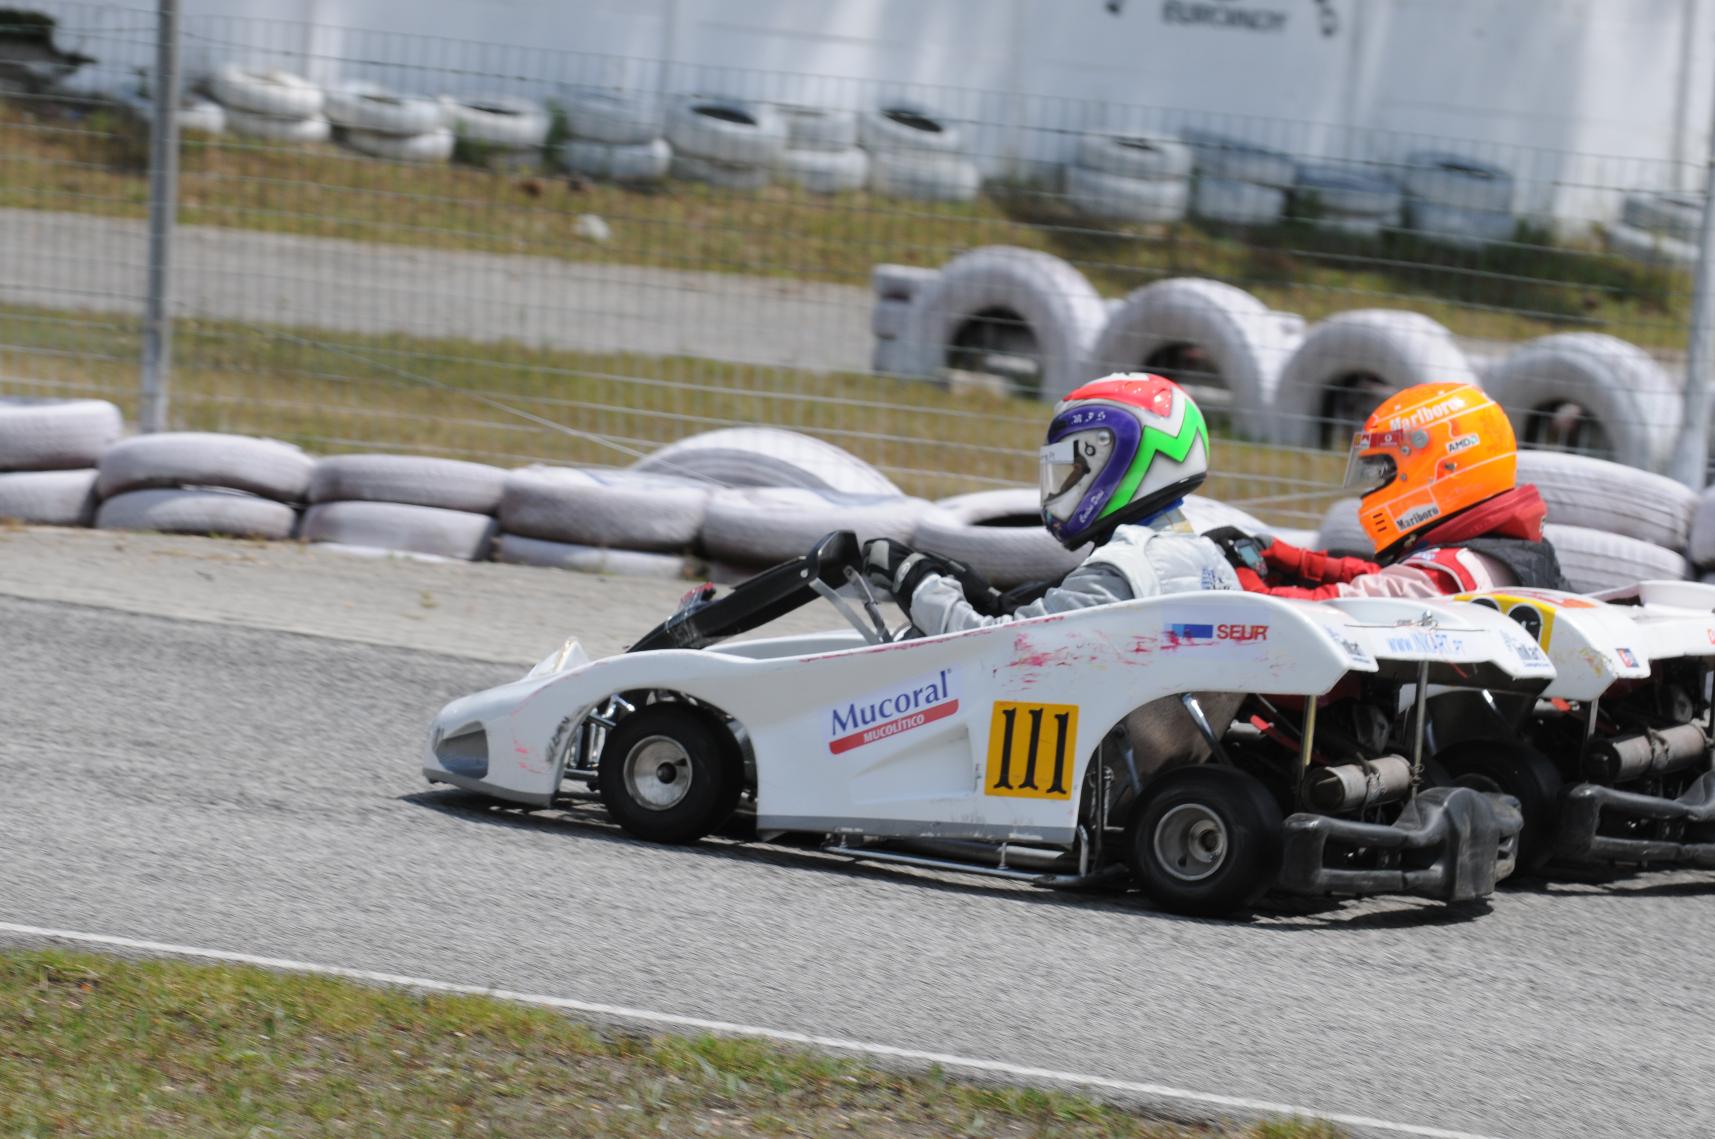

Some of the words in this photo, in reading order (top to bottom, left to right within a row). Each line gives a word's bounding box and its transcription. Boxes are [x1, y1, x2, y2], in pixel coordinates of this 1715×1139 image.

[1390, 398, 1466, 432] Marlboro
[1448, 438, 1471, 452] AMD
[1396, 506, 1440, 531] Marlboro
[1216, 624, 1269, 641] SEUR
[832, 670, 948, 736] Mucoral
[864, 713, 925, 743] MUCOLÍTICO
[993, 707, 1070, 795] 111
